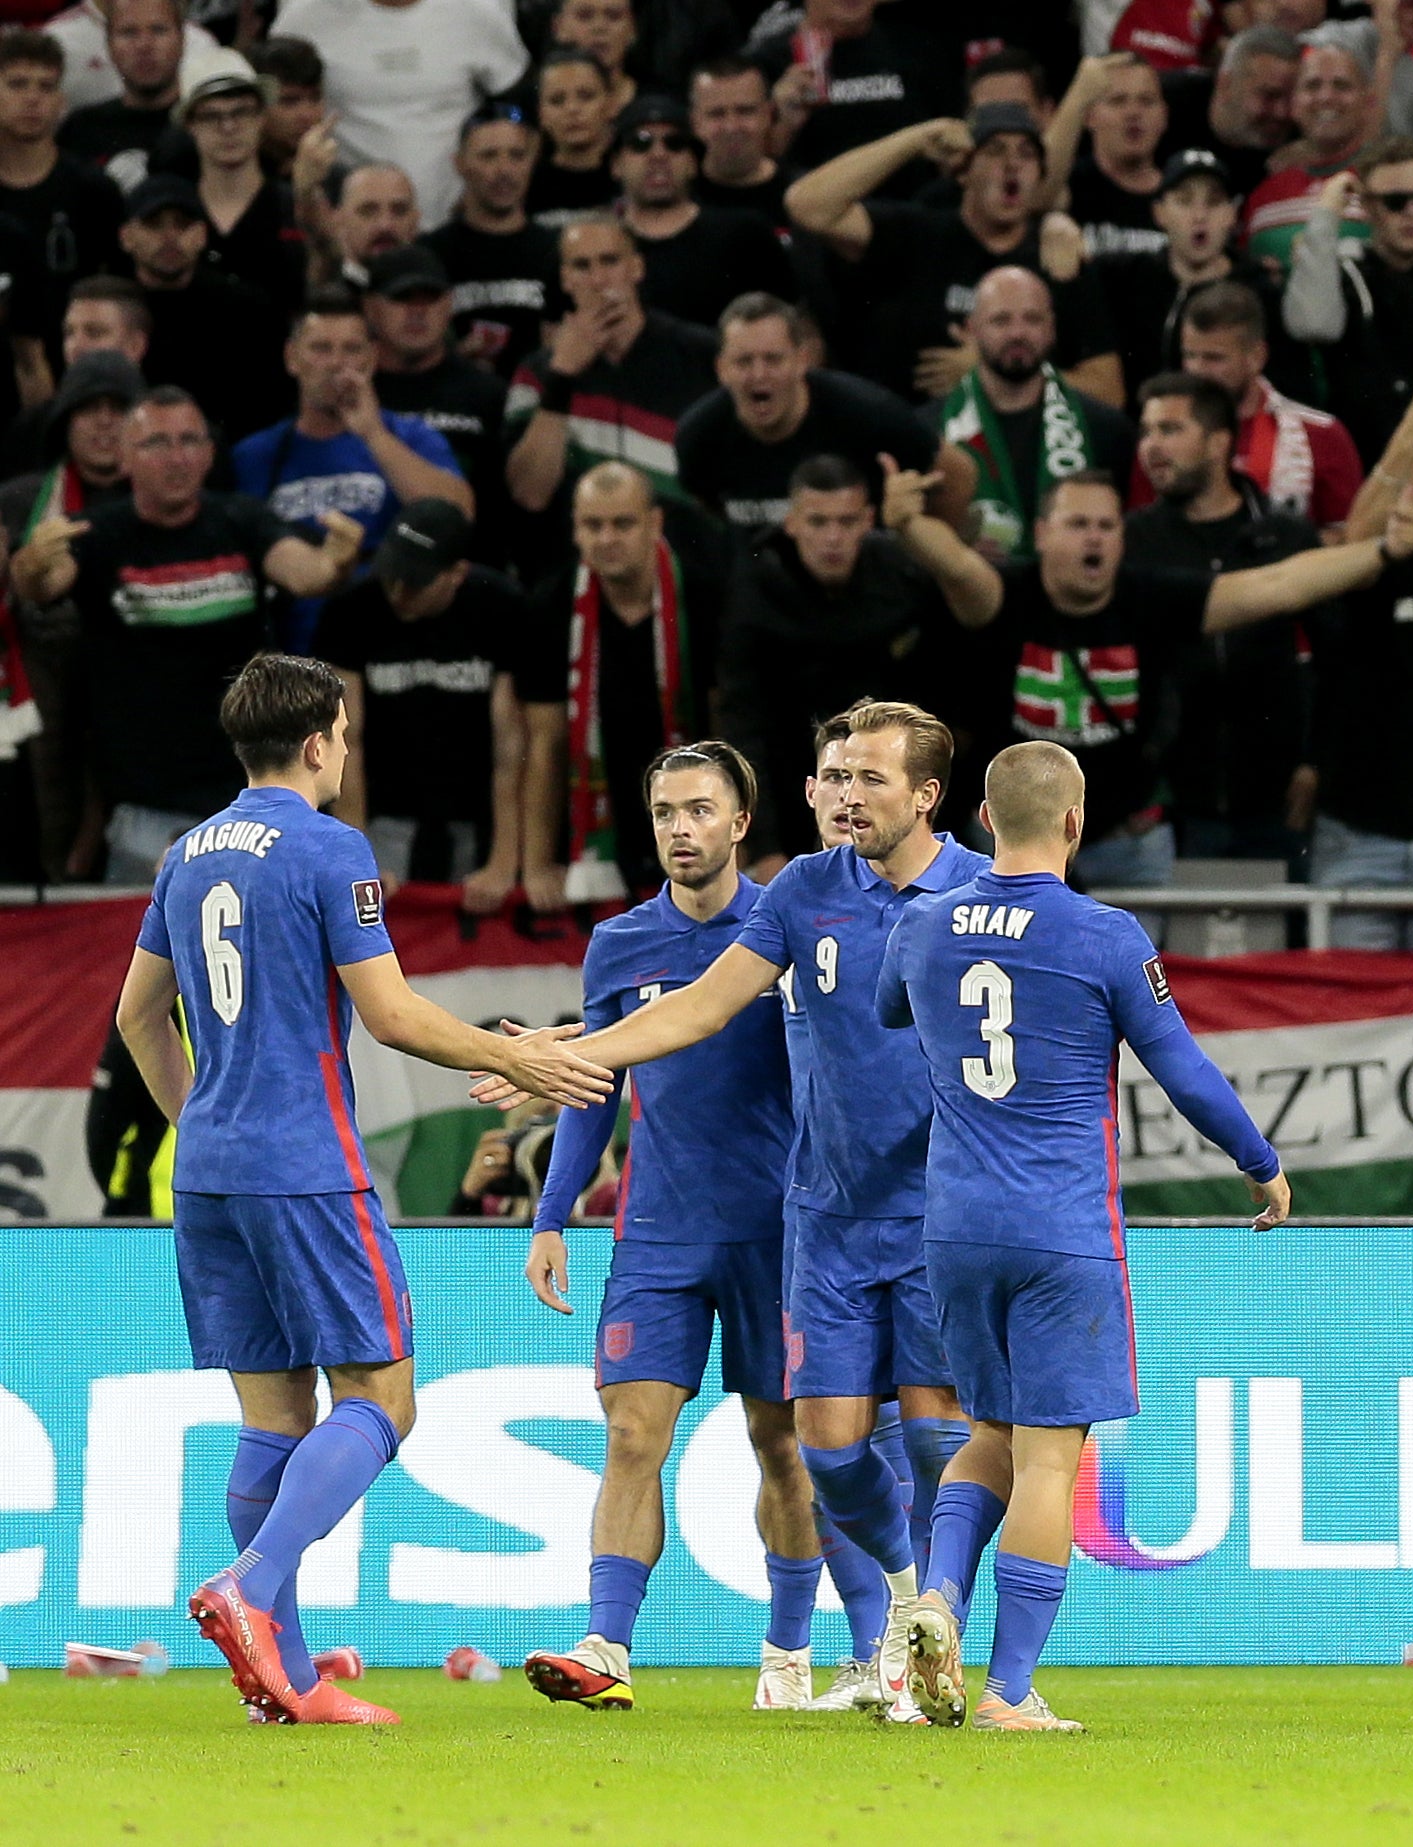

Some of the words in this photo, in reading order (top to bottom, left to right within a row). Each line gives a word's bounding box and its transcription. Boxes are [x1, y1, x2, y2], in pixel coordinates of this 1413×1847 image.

[184, 820, 282, 864] MAGUIRE
[952, 904, 1034, 940] SHAW
[201, 881, 243, 1026] 6
[816, 936, 838, 994] 9
[959, 960, 1017, 1101] 3
[226, 1587, 254, 1646] ULTRA
